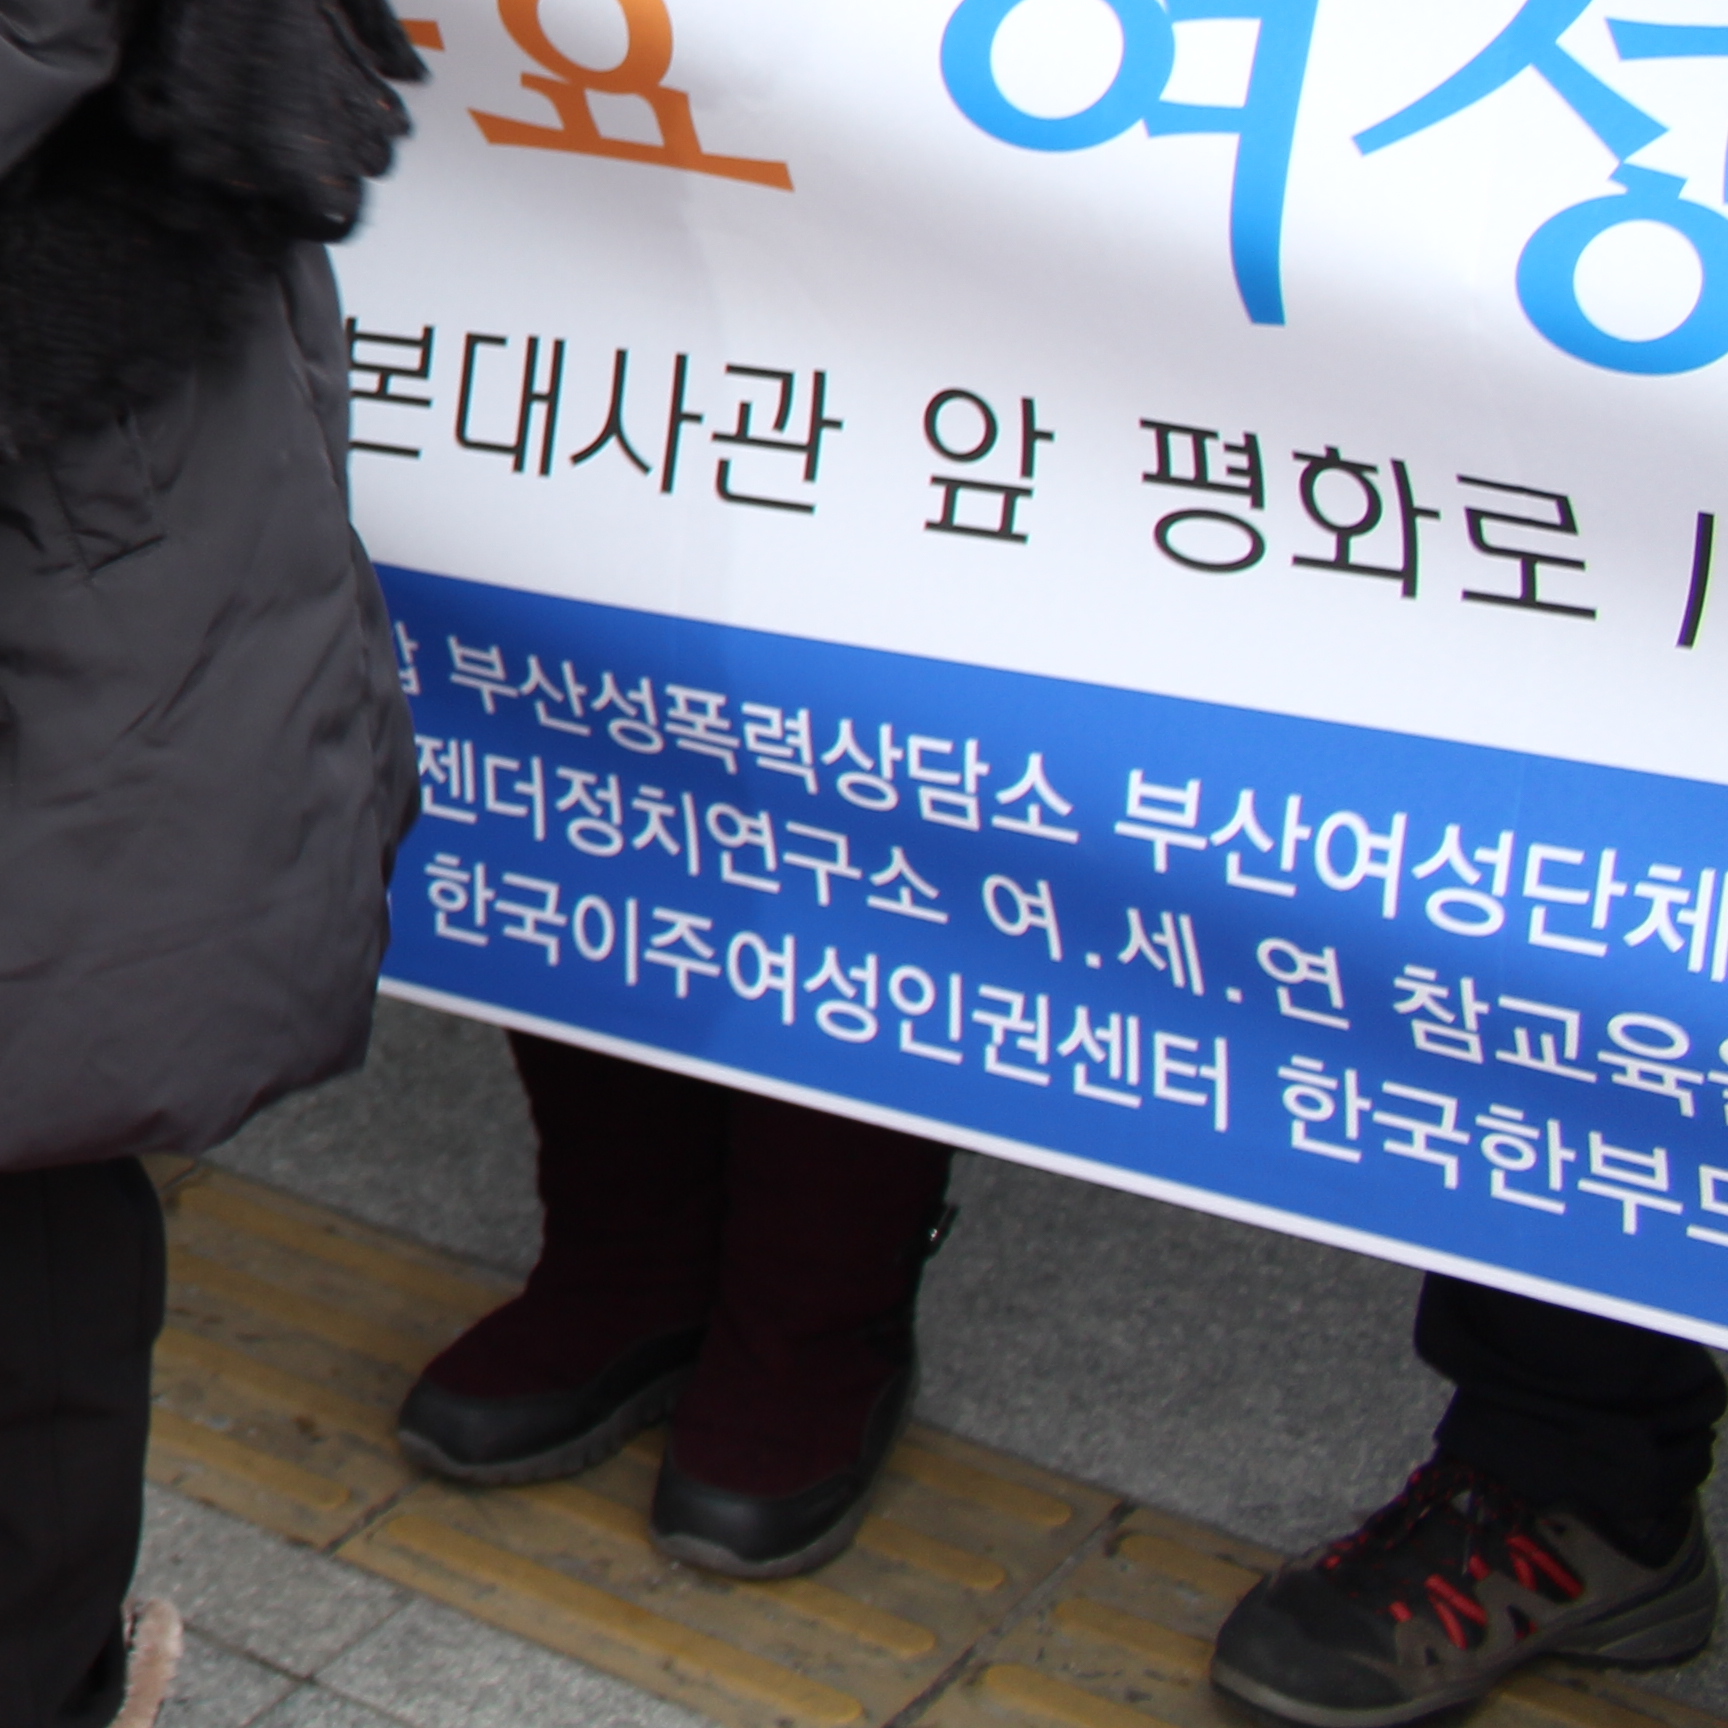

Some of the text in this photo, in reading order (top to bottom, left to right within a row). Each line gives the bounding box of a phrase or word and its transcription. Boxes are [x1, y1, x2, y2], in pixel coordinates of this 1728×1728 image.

[922, 385, 1056, 546] 앞
[1138, 416, 1598, 622] 평화로
[413, 732, 949, 925] 젠더정치연구소
[447, 634, 1728, 983] 부산성폭력상담소 부산여성단체
[423, 852, 1230, 1134] 한국이주여성인권센터
